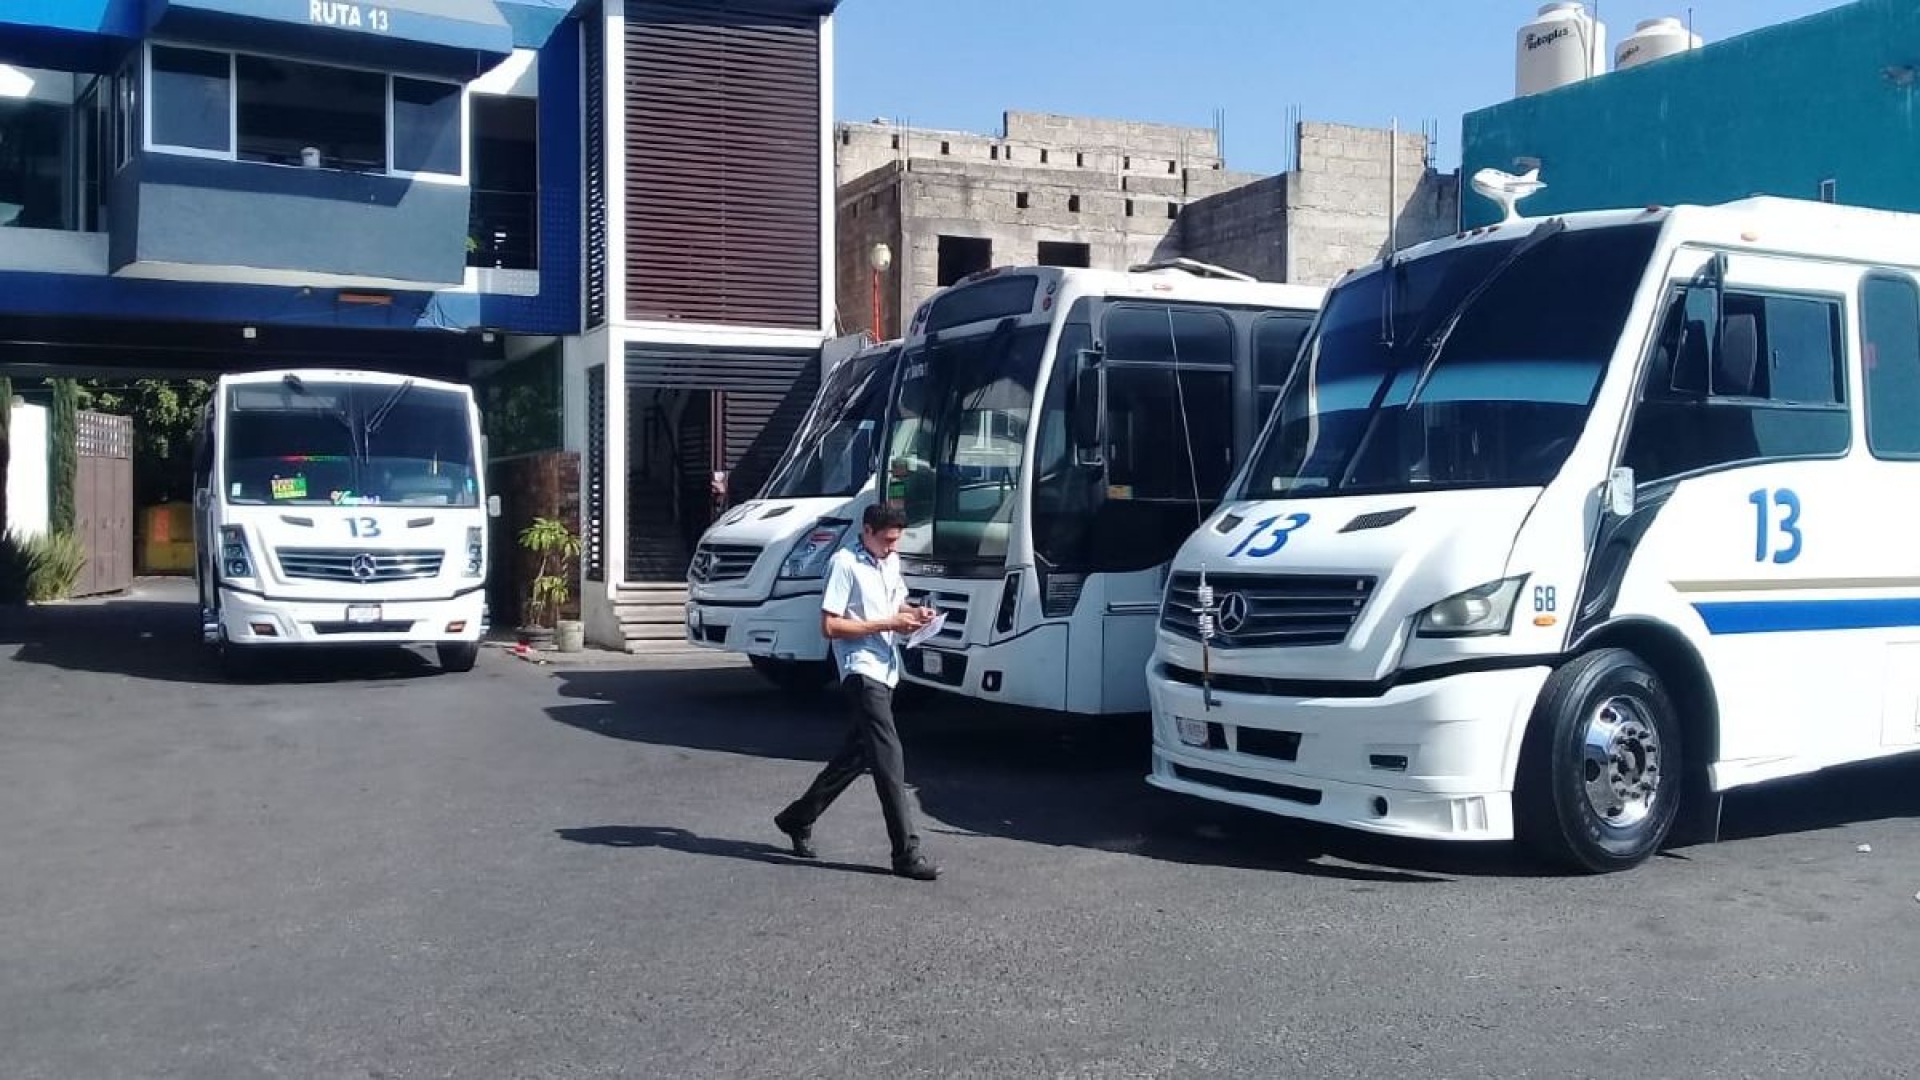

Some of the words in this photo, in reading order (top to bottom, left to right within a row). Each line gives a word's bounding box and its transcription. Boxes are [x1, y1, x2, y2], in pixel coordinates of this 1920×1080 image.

[309, 0, 362, 27] RUTA
[368, 8, 389, 31] 13
[342, 517, 382, 538] 13
[1226, 512, 1311, 558] 13
[1749, 488, 1802, 564] 13
[1534, 586, 1556, 612] 68
